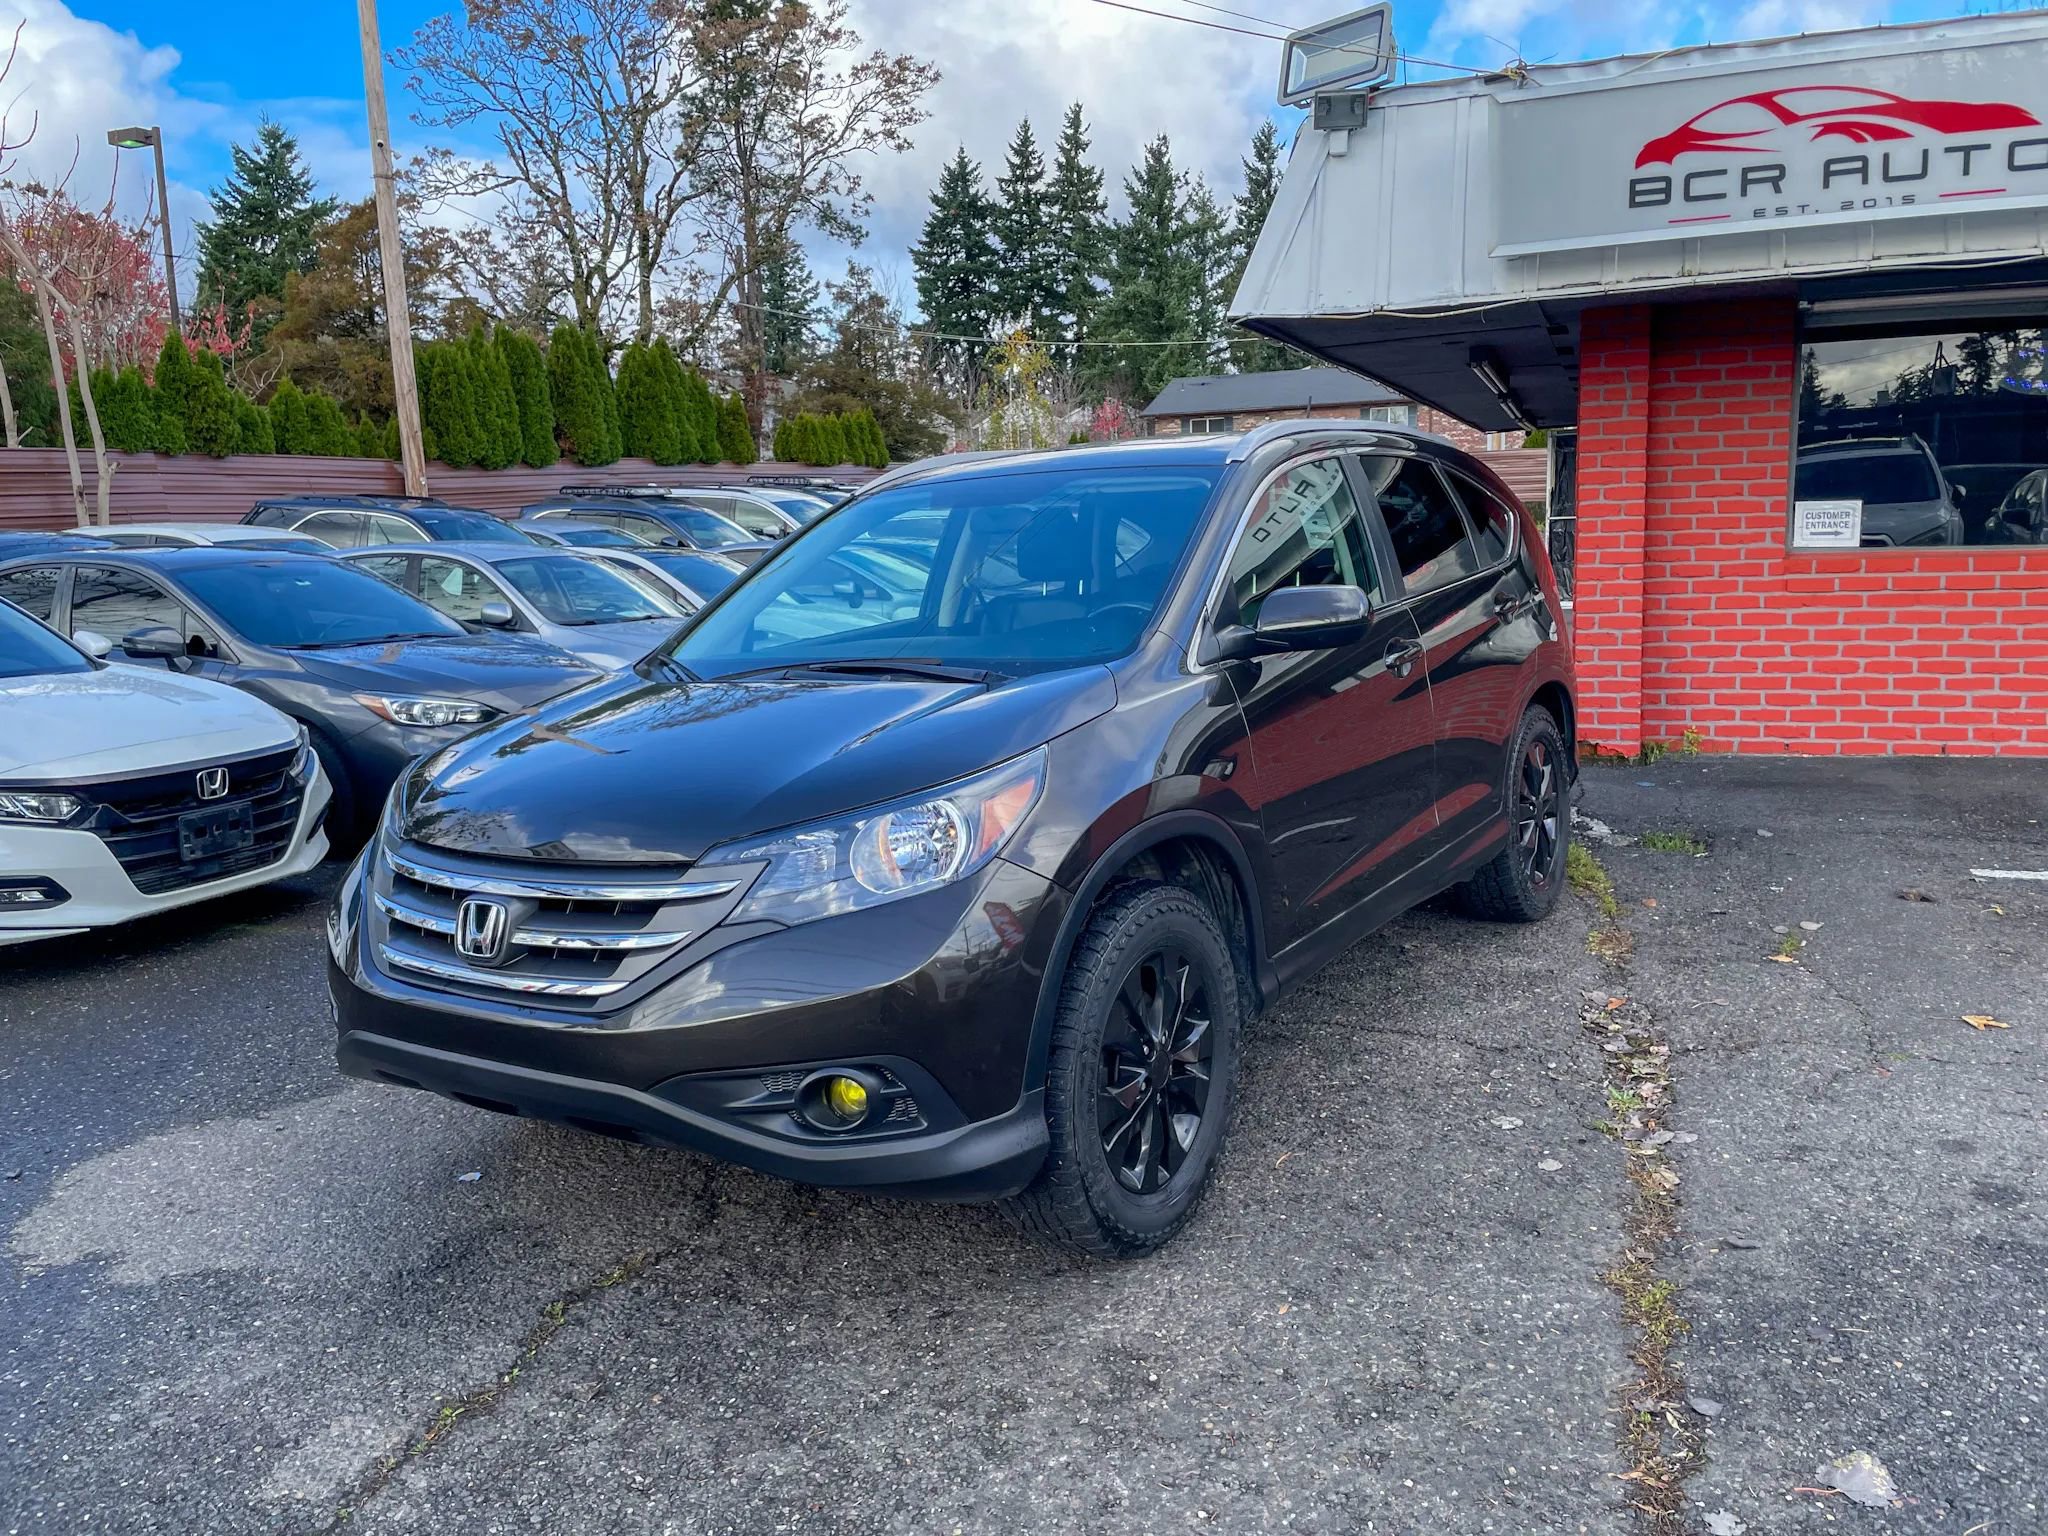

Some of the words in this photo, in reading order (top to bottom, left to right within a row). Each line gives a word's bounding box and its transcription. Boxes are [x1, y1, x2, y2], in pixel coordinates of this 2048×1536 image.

[1629, 163, 1786, 208] BCR
[1823, 138, 2048, 189] AUTO
[1753, 204, 1819, 218] EST.
[1840, 194, 1916, 210] 2015
[1805, 511, 1851, 520] CUSTOMER
[1805, 520, 1850, 529] ENTRANCE
